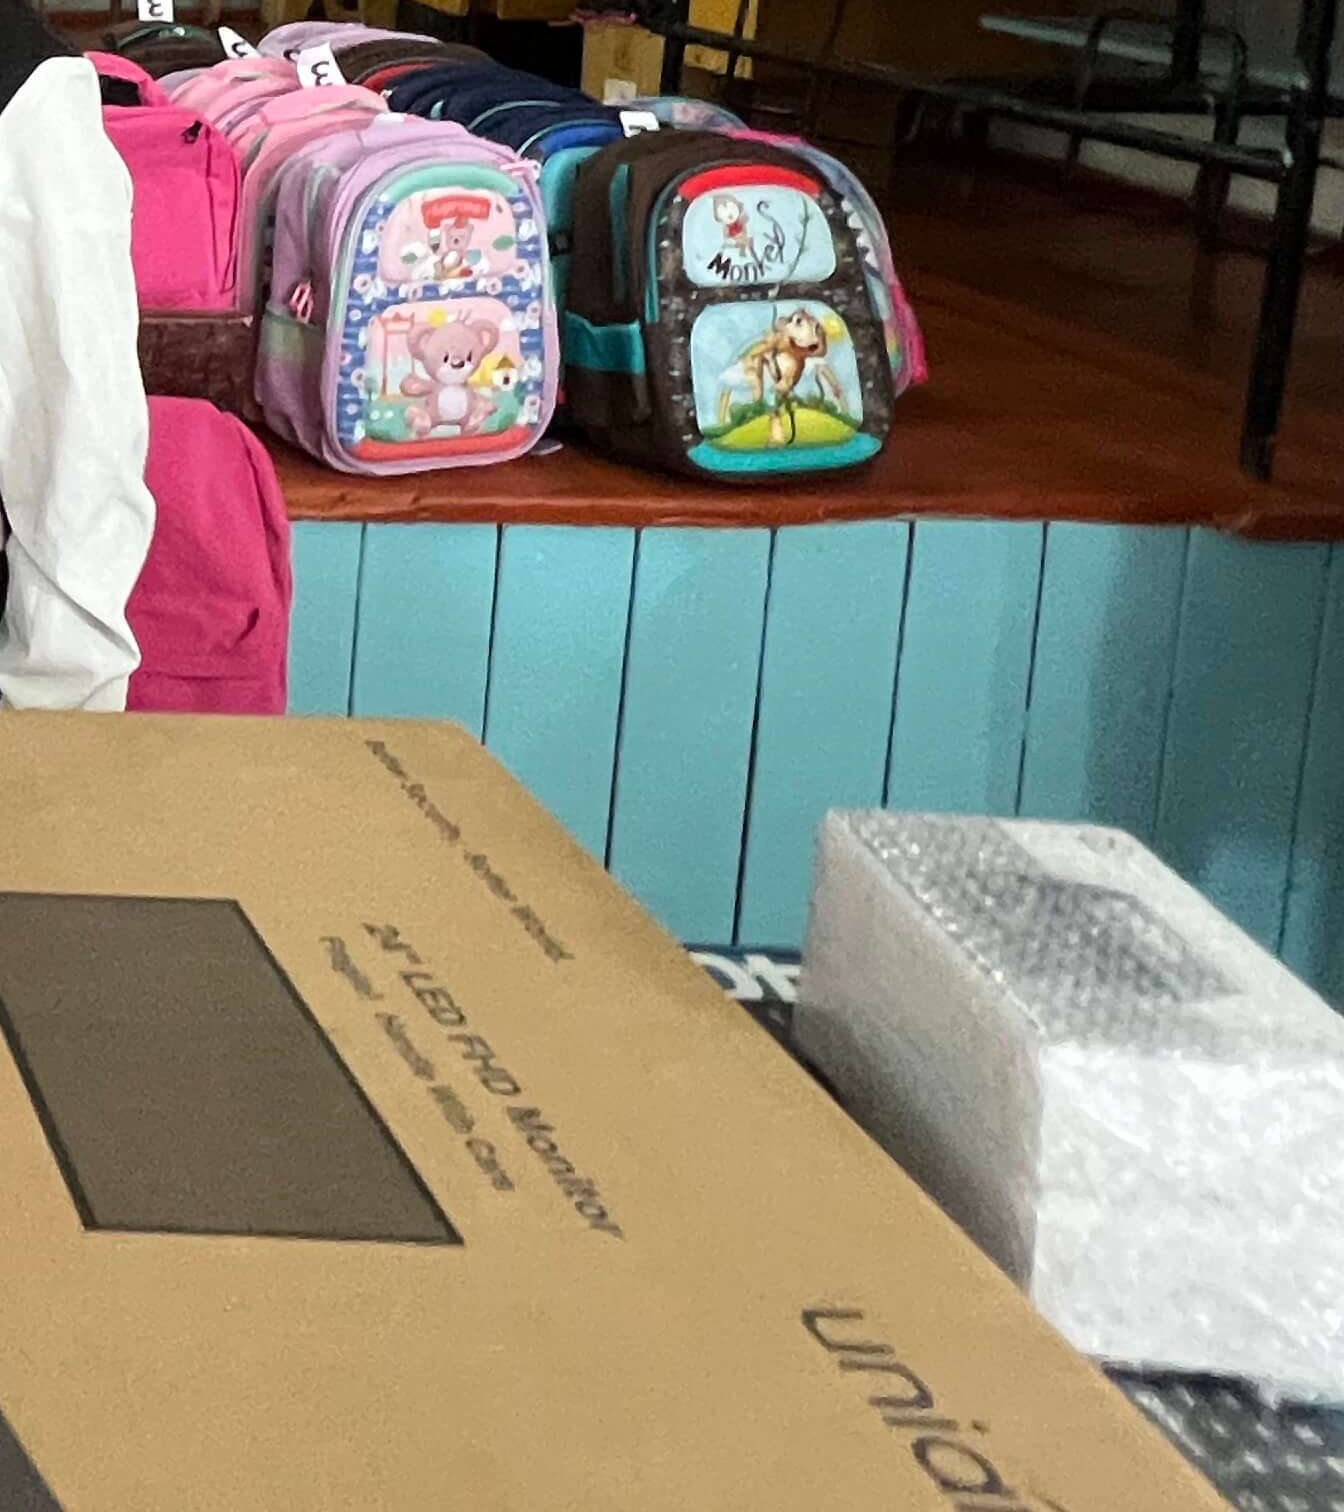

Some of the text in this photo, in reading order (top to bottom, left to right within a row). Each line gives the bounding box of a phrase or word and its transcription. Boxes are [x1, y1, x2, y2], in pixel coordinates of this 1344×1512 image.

[400, 970, 466, 1026] LED
[446, 1032, 521, 1096] FHD
[507, 1105, 625, 1240] Monitor
